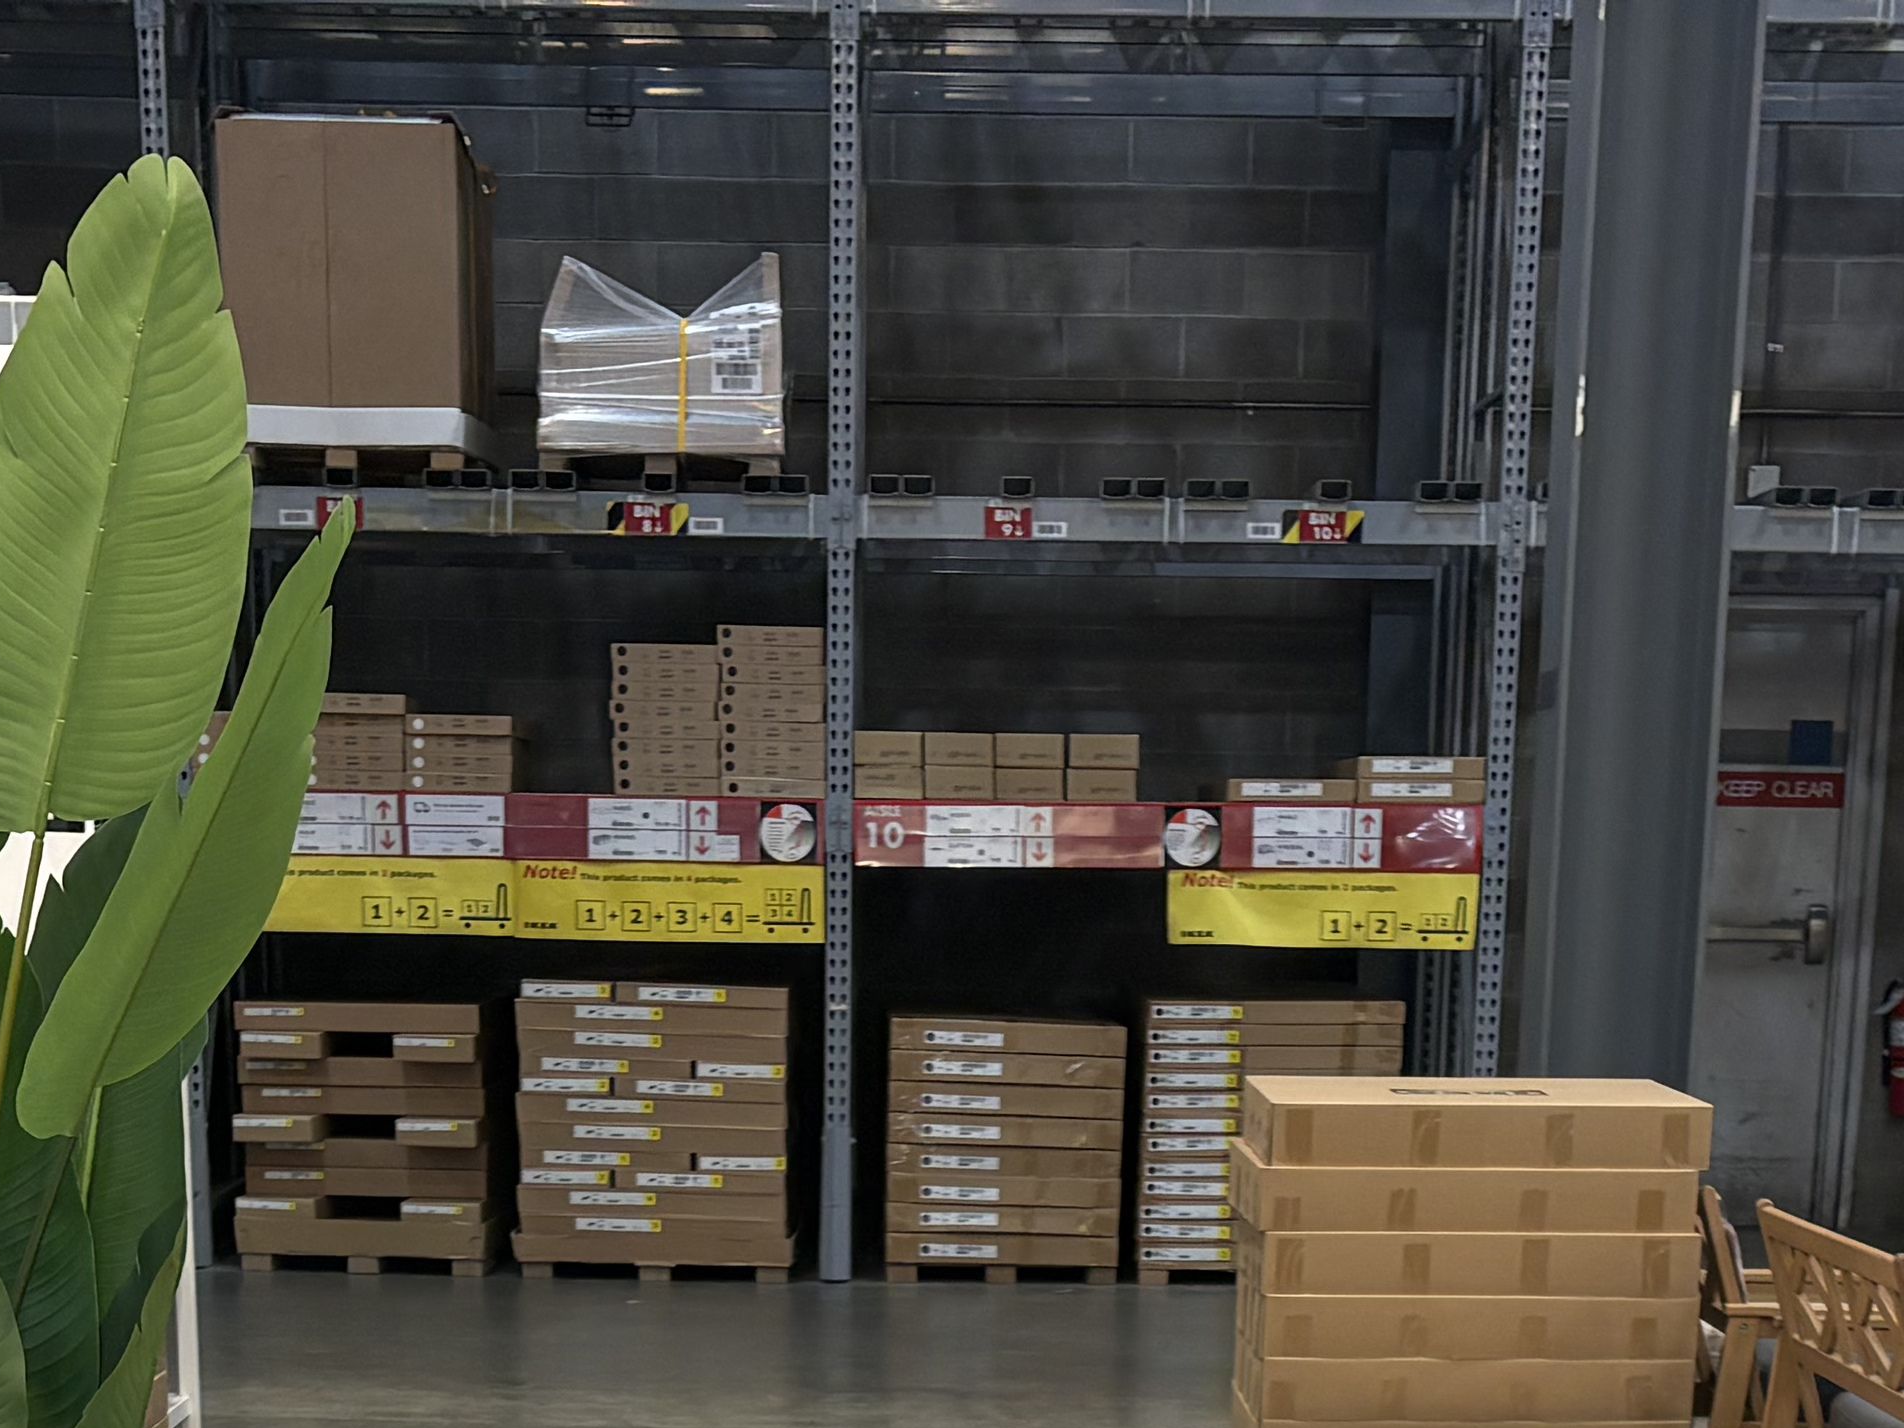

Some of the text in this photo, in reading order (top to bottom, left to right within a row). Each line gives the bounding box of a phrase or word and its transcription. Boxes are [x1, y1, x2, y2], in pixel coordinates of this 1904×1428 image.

[632, 503, 661, 519] BIN
[994, 508, 1022, 522] BIN
[1308, 511, 1337, 526] BIN
[1000, 523, 1012, 537] 9
[1313, 526, 1332, 540] 10
[1771, 780, 1834, 799] CLEAR
[864, 821, 905, 849] 10
[522, 863, 578, 880] Note!
[1180, 872, 1234, 889] Note!
[370, 903, 383, 919] 1
[416, 904, 430, 920] 2
[584, 908, 597, 923] 1
[630, 908, 644, 924] 2
[674, 909, 688, 925] 3
[720, 910, 734, 926] 4
[1329, 918, 1342, 934] 1
[1374, 919, 1389, 934] 2
